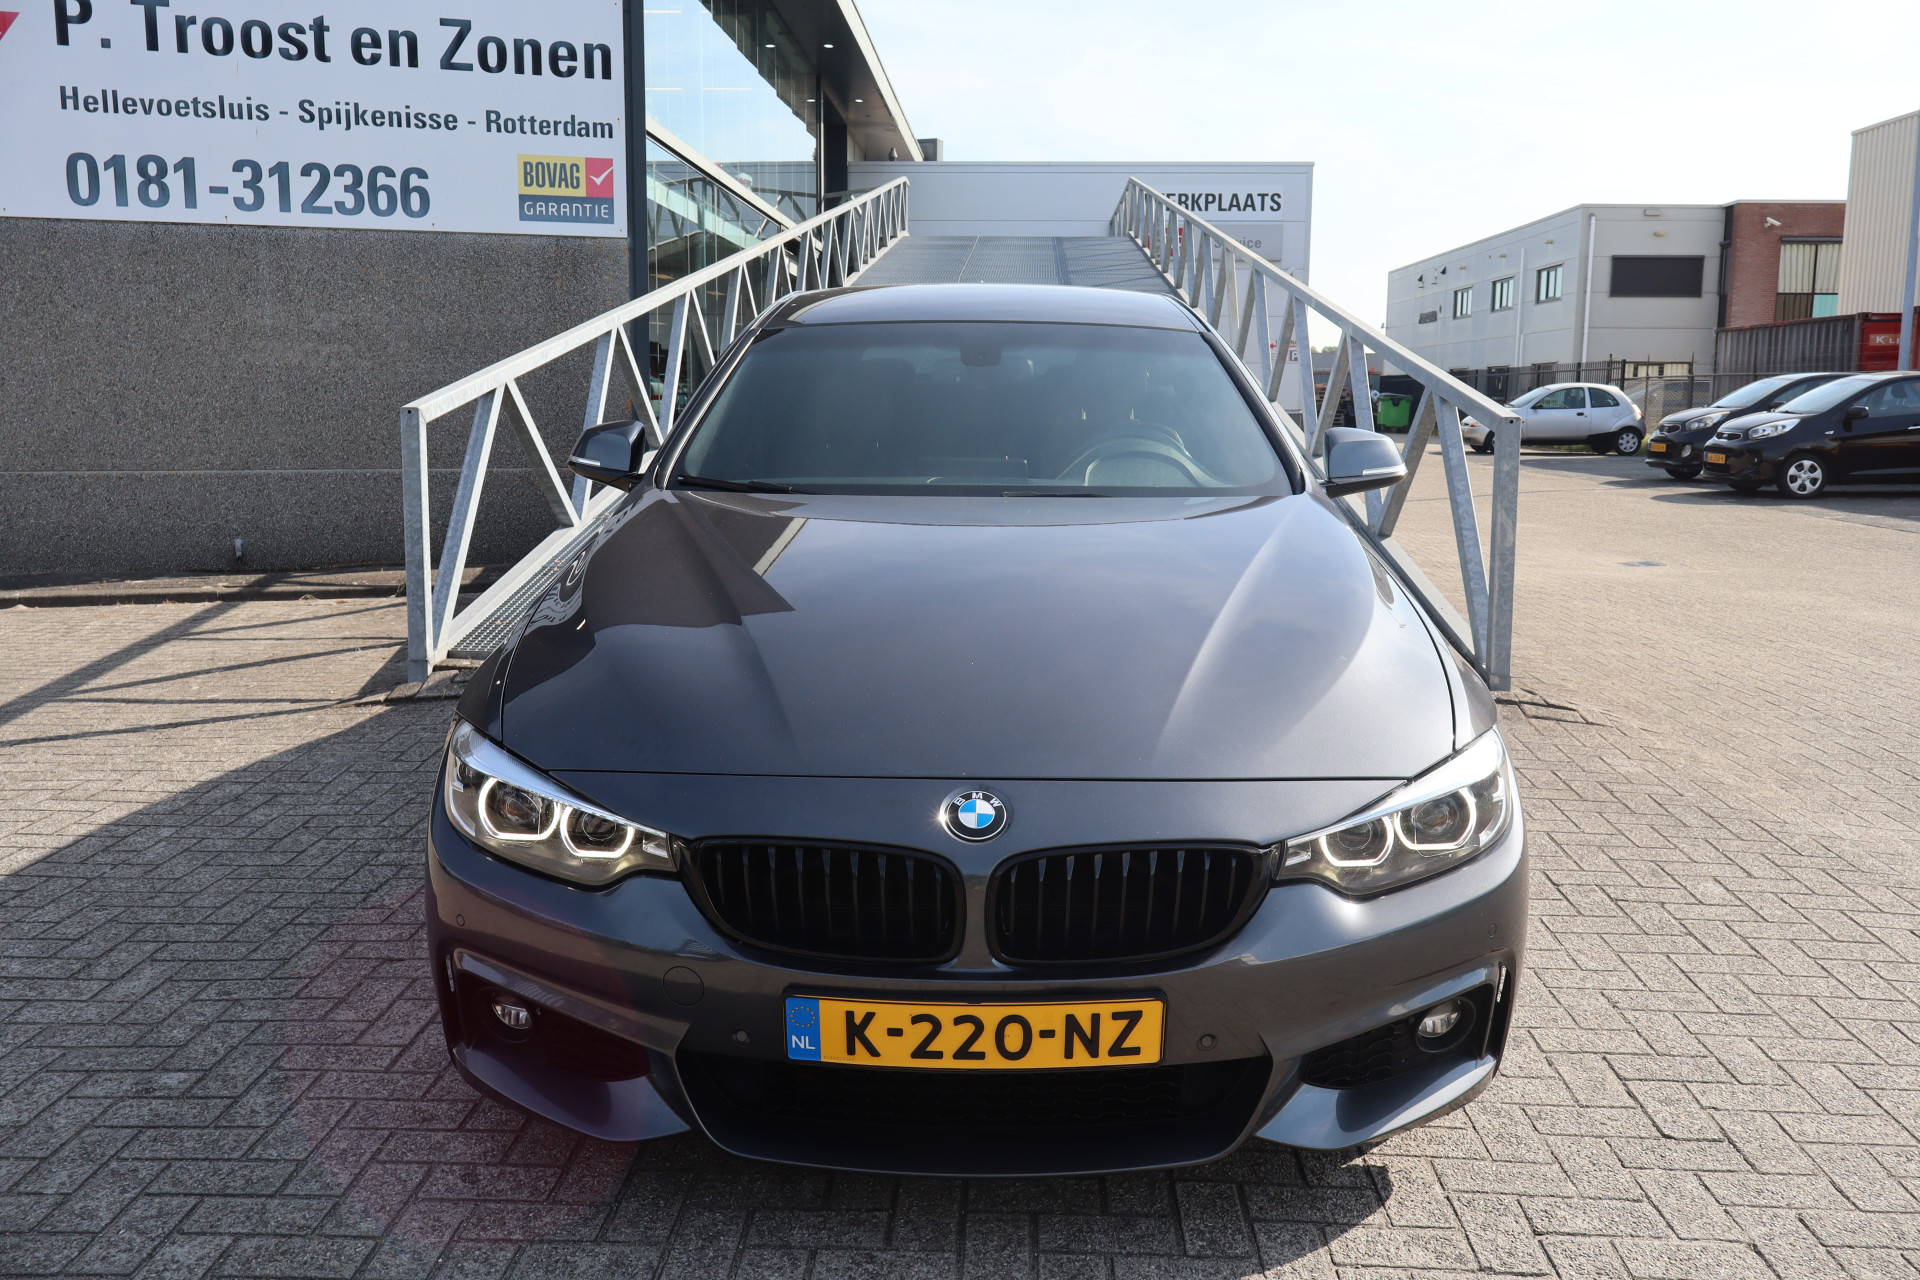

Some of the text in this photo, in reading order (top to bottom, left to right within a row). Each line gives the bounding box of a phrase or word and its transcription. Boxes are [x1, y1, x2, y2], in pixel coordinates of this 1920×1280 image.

[53, 0, 612, 80] P. Troost en Zonen
[59, 85, 270, 121] Hellevoetsluis
[298, 99, 458, 131] Spijkenisse
[485, 109, 613, 139] Rotterdam
[66, 152, 431, 219] 0181-312366
[523, 161, 580, 189] BOVAG
[524, 202, 609, 218] GARANTIE
[1161, 193, 1282, 211] ERKPLAATS
[954, 792, 1002, 807] BMW
[791, 1010, 1143, 1061] NL K-220-NZ
